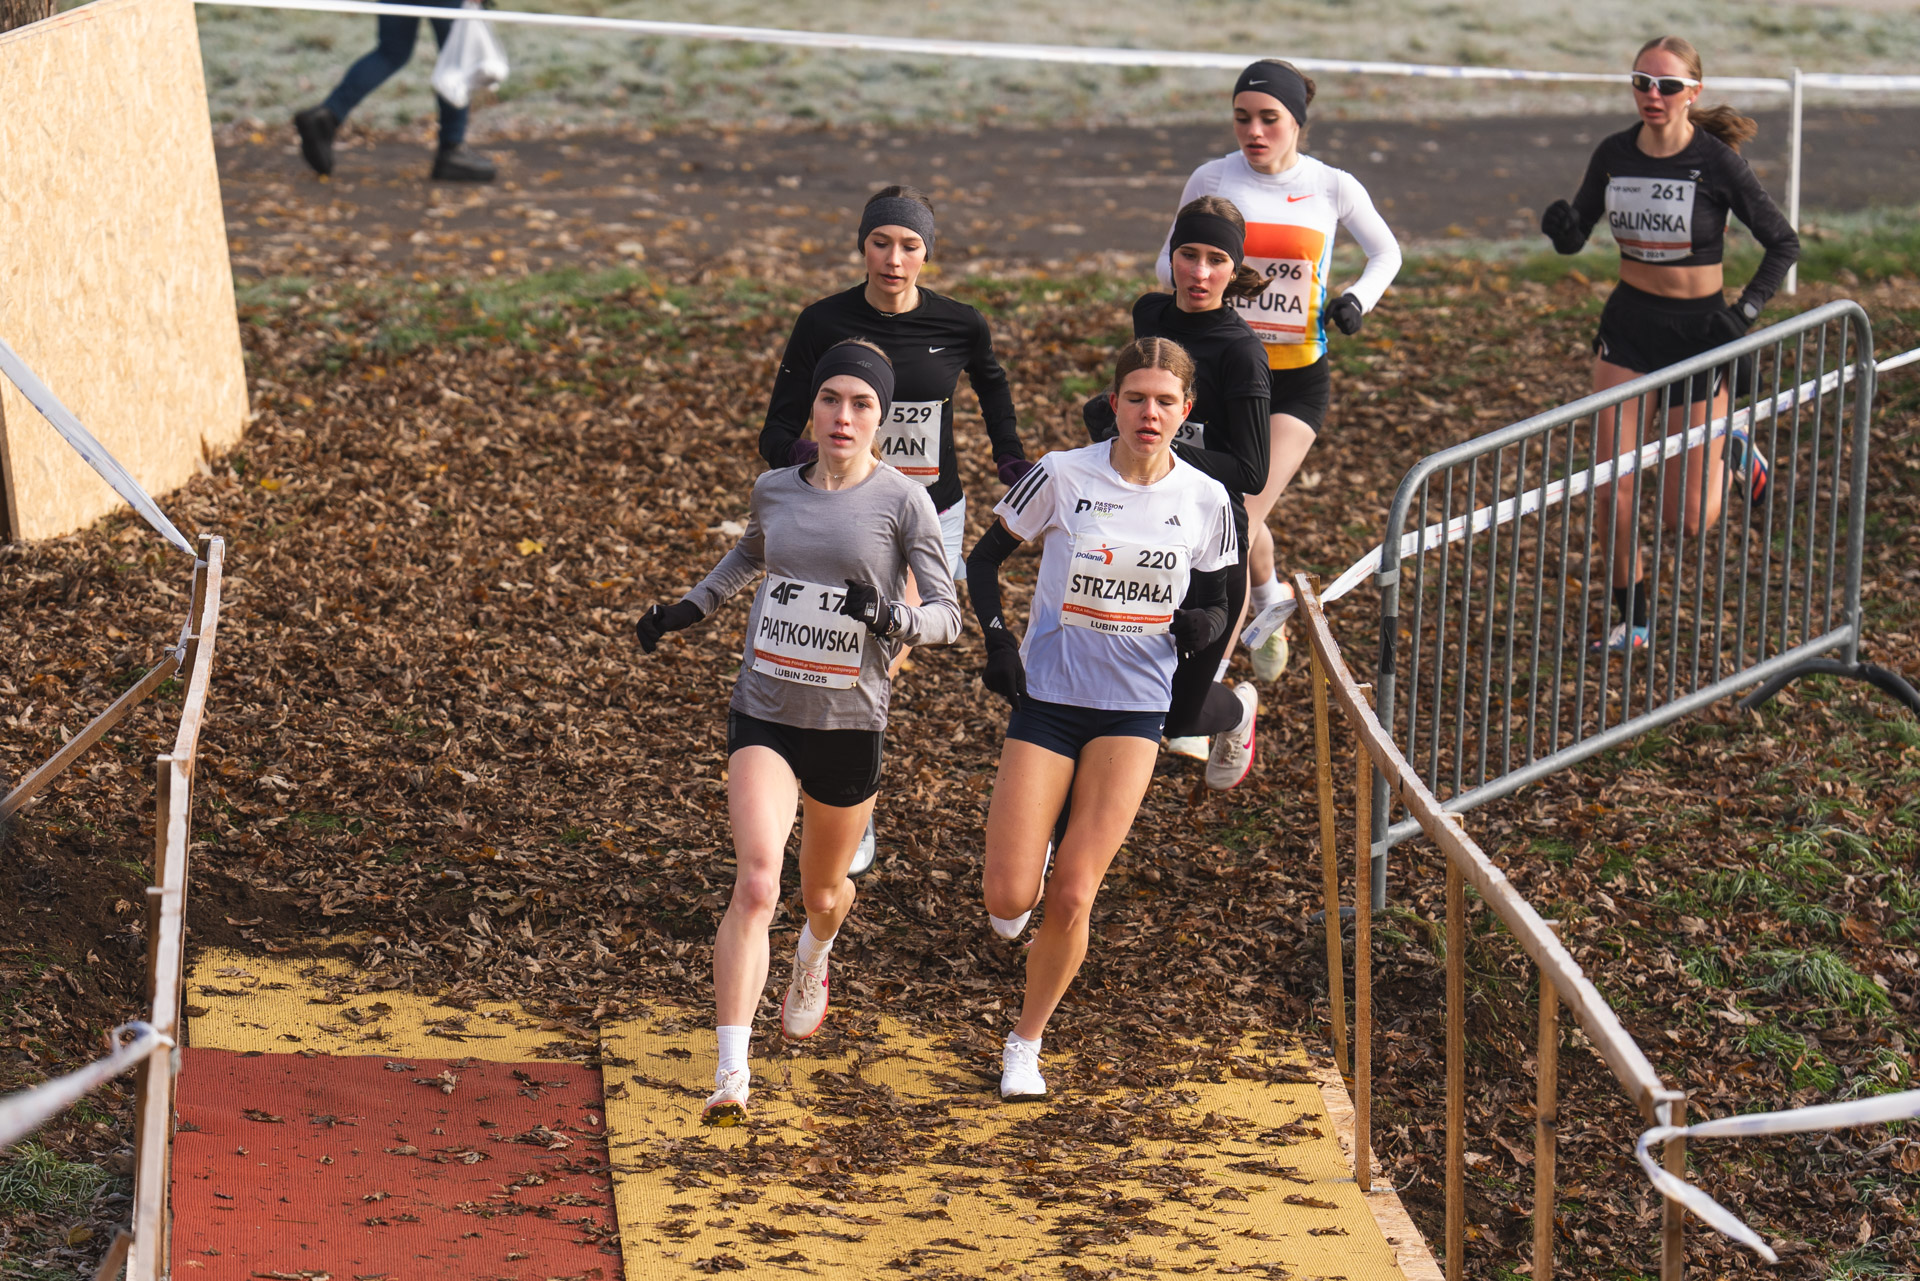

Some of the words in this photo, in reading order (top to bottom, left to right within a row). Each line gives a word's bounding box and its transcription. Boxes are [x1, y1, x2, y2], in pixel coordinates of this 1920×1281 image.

[1651, 183, 1685, 202] 261
[1609, 208, 1686, 233] GALIŃSKA
[1265, 263, 1302, 280] 696
[892, 406, 932, 424] 529
[1095, 501, 1124, 510] PASSION
[1075, 551, 1104, 563] polanik
[1136, 550, 1177, 570] 220
[770, 581, 805, 605] 4F
[1070, 574, 1173, 605] STRZĄBAŁA
[760, 616, 859, 653] PIĄTKOWSKA
[1090, 620, 1119, 632] LUBIN
[1120, 625, 1143, 633] 2025
[774, 667, 800, 680] LUBIN
[802, 673, 828, 684] 2025
